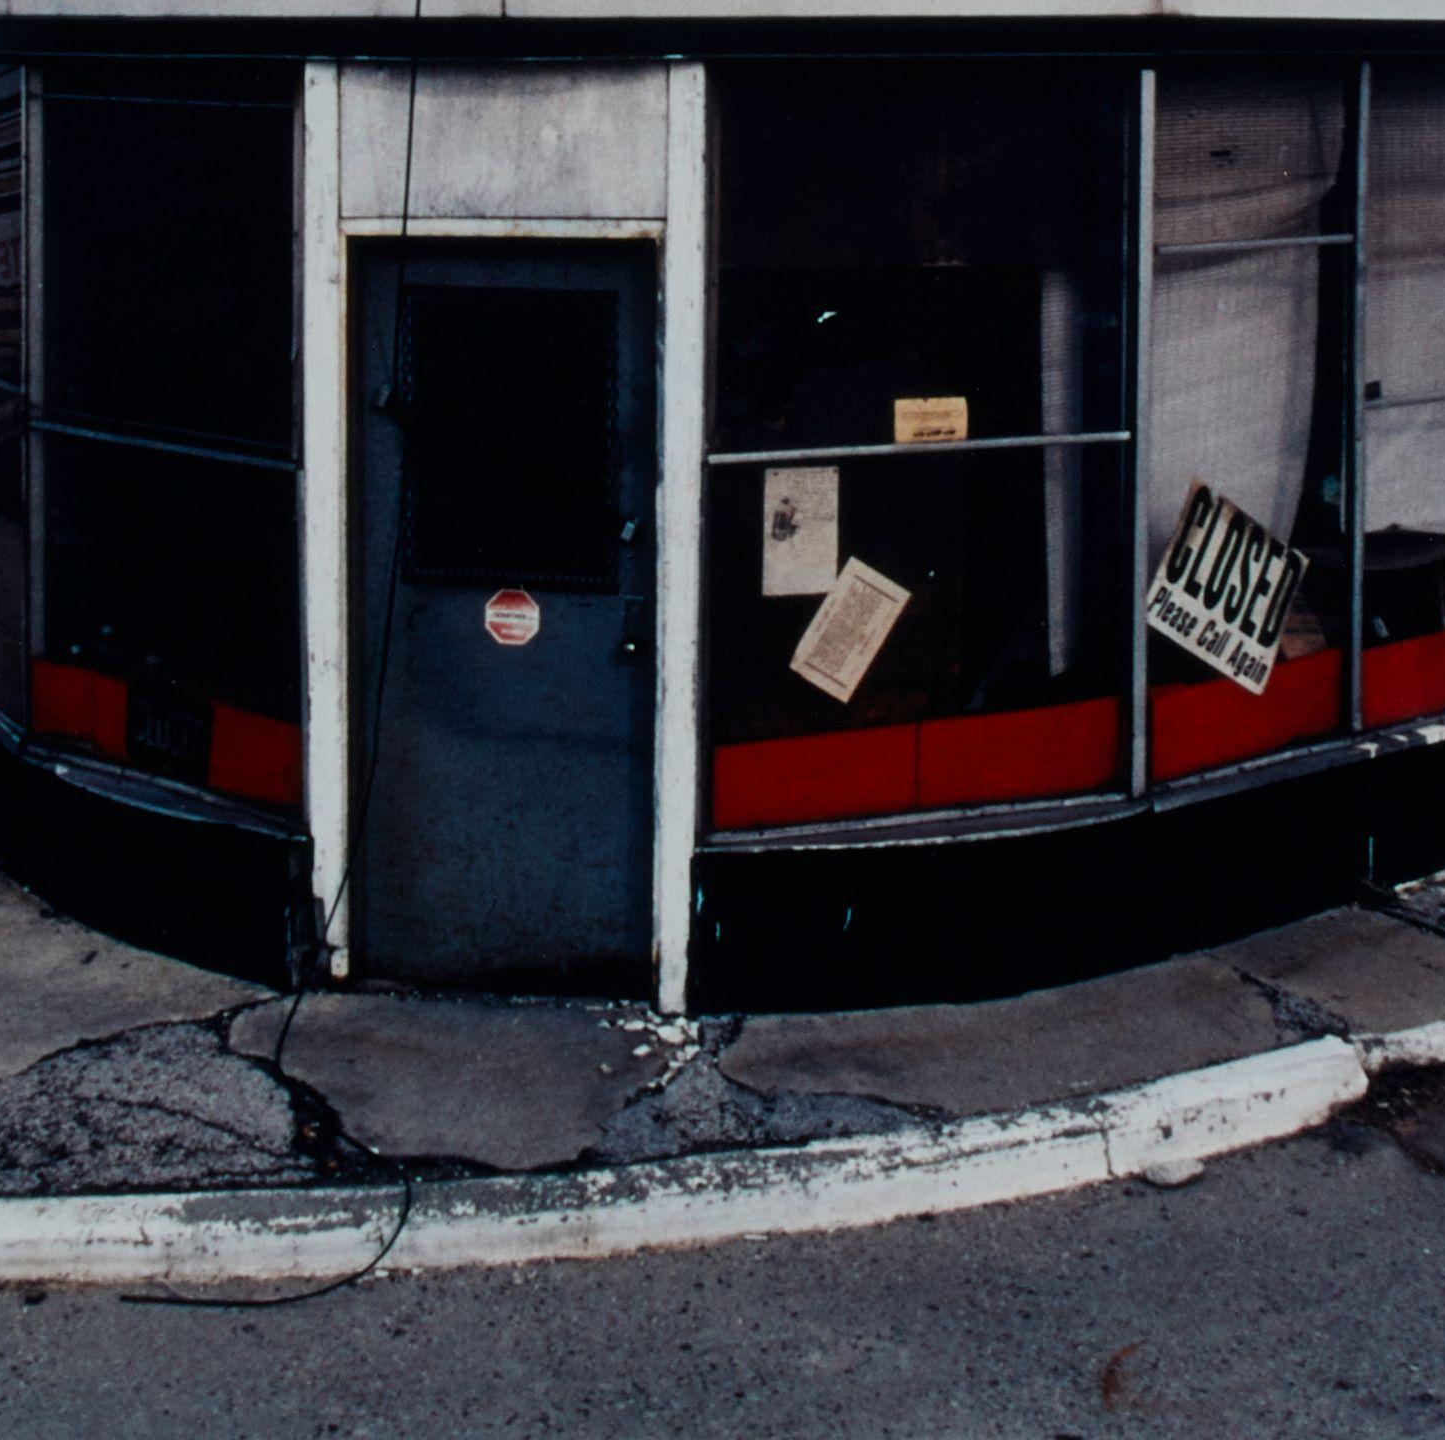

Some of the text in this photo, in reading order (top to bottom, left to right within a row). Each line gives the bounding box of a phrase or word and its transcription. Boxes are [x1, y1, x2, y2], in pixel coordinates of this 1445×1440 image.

[1166, 485, 1303, 648] CLOSED
[1147, 586, 1269, 686] Please Call Again
